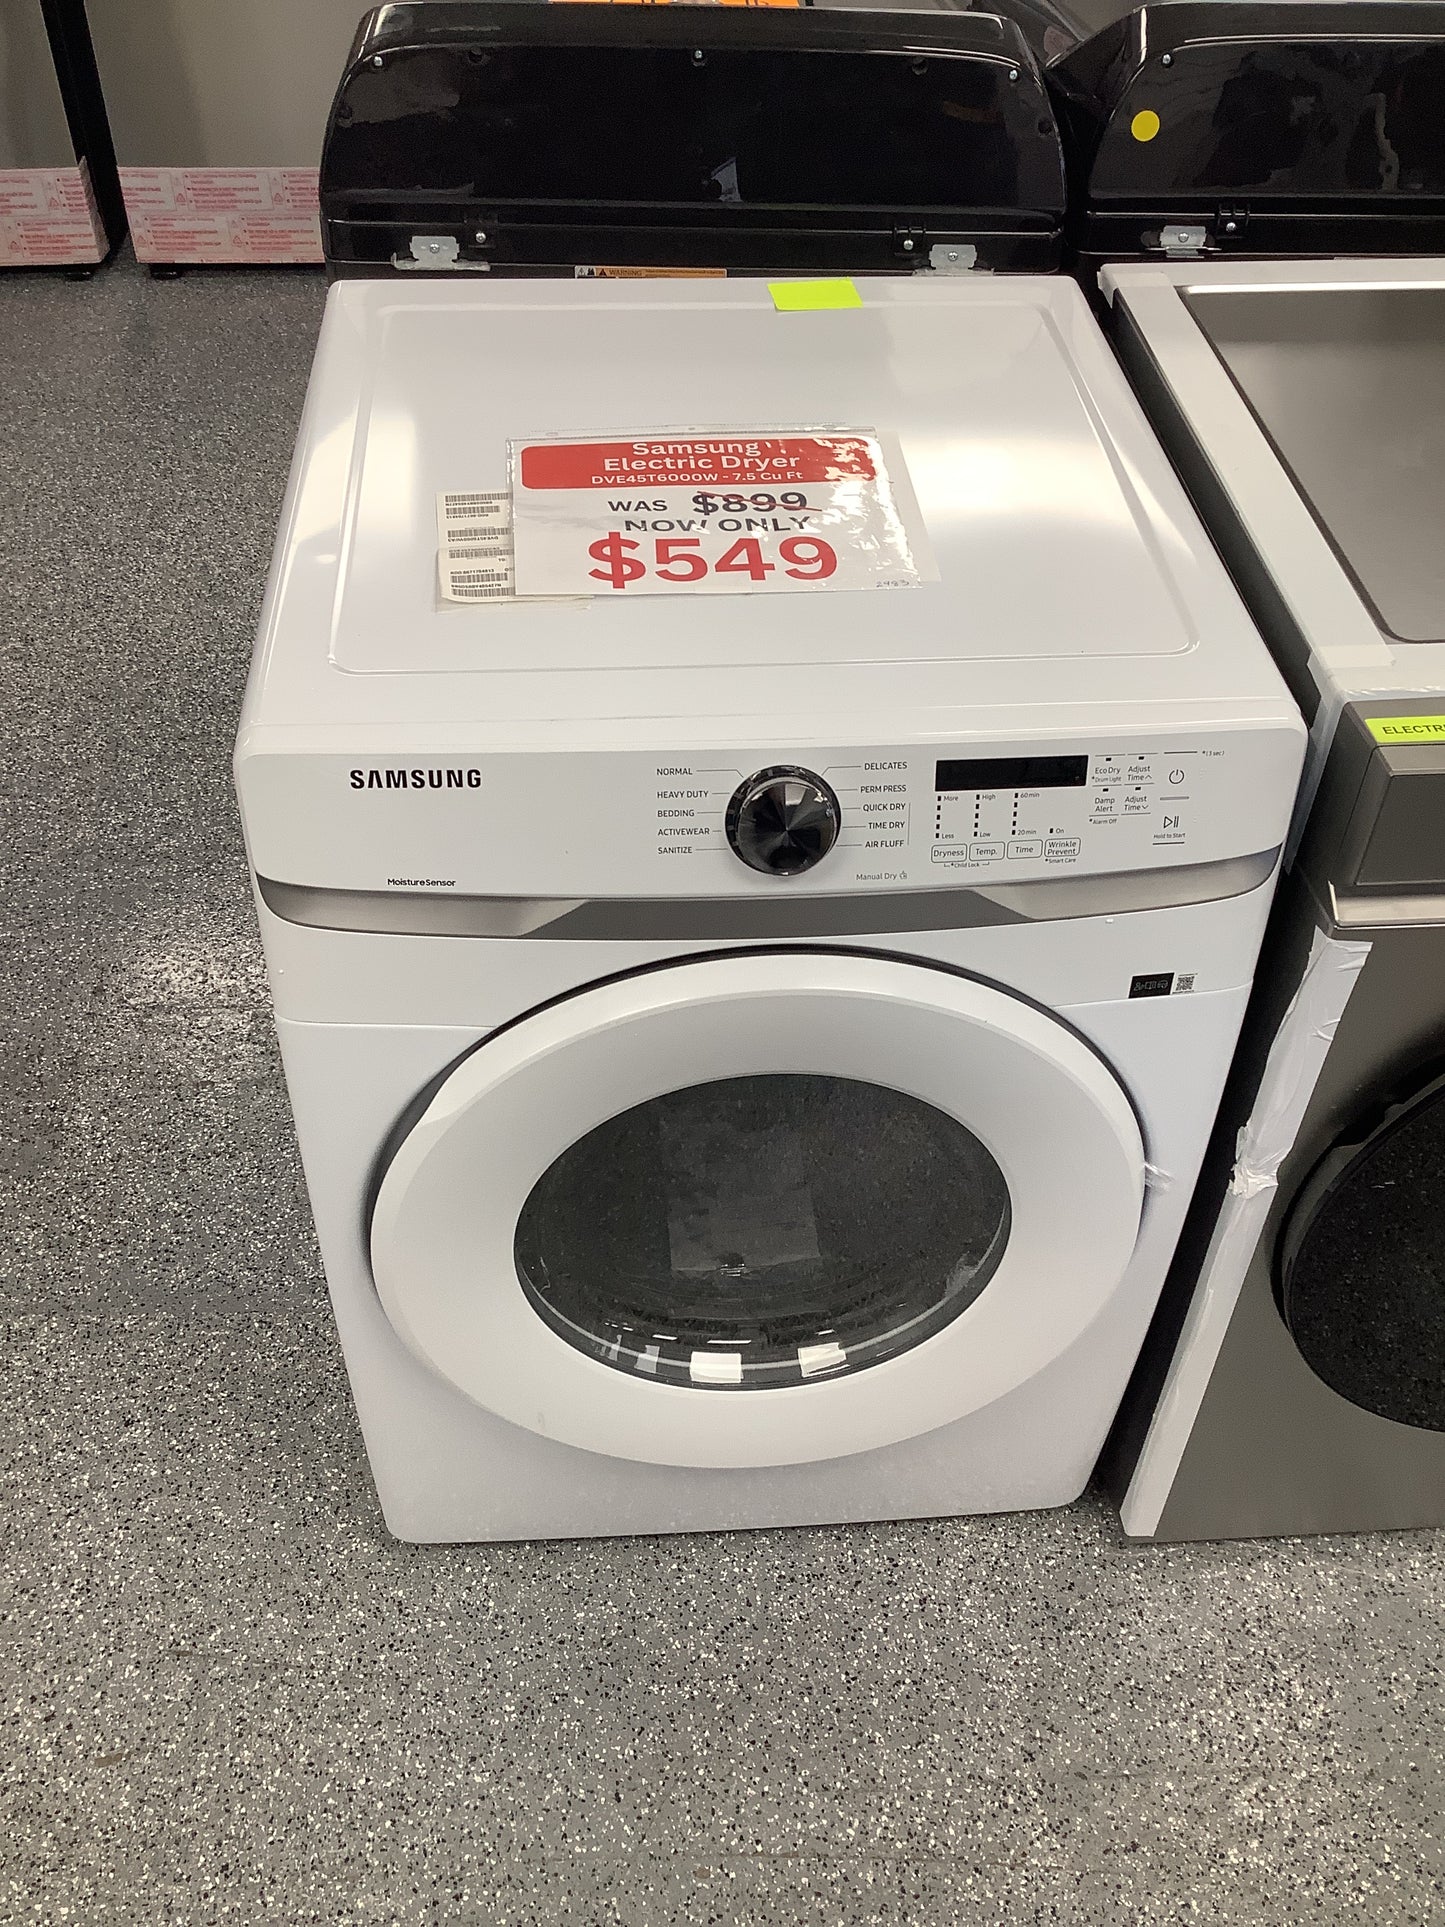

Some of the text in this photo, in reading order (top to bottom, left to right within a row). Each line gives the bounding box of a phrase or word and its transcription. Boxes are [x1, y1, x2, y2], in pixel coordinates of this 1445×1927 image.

[632, 442, 762, 456] Samsung
[604, 456, 800, 471] Electric Dryer
[592, 472, 718, 484] DVE45T6000W
[732, 472, 756, 481] 7.5
[760, 472, 782, 480] Cu
[787, 471, 803, 479] Ft
[608, 492, 808, 515] WAS $899
[625, 516, 810, 532] NOW ONLY
[588, 532, 837, 589] $549
[1382, 724, 1445, 734] ELECTR
[864, 761, 907, 771] DELICATES
[1128, 765, 1151, 775] Adjust
[656, 767, 693, 776] NORMAL
[1095, 766, 1121, 776] Eco Dry
[350, 769, 481, 789] SAMSUNG
[1110, 775, 1122, 783] Light
[1128, 773, 1145, 782] Time
[860, 784, 907, 794] PERM PRESS
[657, 790, 709, 799] HEAVY DUTY
[943, 794, 959, 802] More
[982, 793, 996, 801] High
[1095, 797, 1115, 806] Damp
[1125, 795, 1147, 804] Adjust
[863, 802, 906, 812] QUICK DRY
[1095, 804, 1113, 812] Alert
[1124, 804, 1141, 812] Time
[657, 809, 694, 818] BEDDING
[868, 820, 905, 830] TIME DRY
[1108, 817, 1117, 825] Off
[658, 827, 710, 836] ACTIVEWEAR
[941, 832, 955, 840] Less
[865, 839, 904, 849] AIR FLUFF
[1048, 840, 1077, 849] Wrinkle
[658, 846, 693, 855] SANITIZE
[933, 849, 964, 858] Dryness
[976, 847, 998, 856] Temp.
[1015, 845, 1034, 854] Time
[1047, 848, 1076, 856] Prevent
[856, 872, 897, 882] Manual Dry
